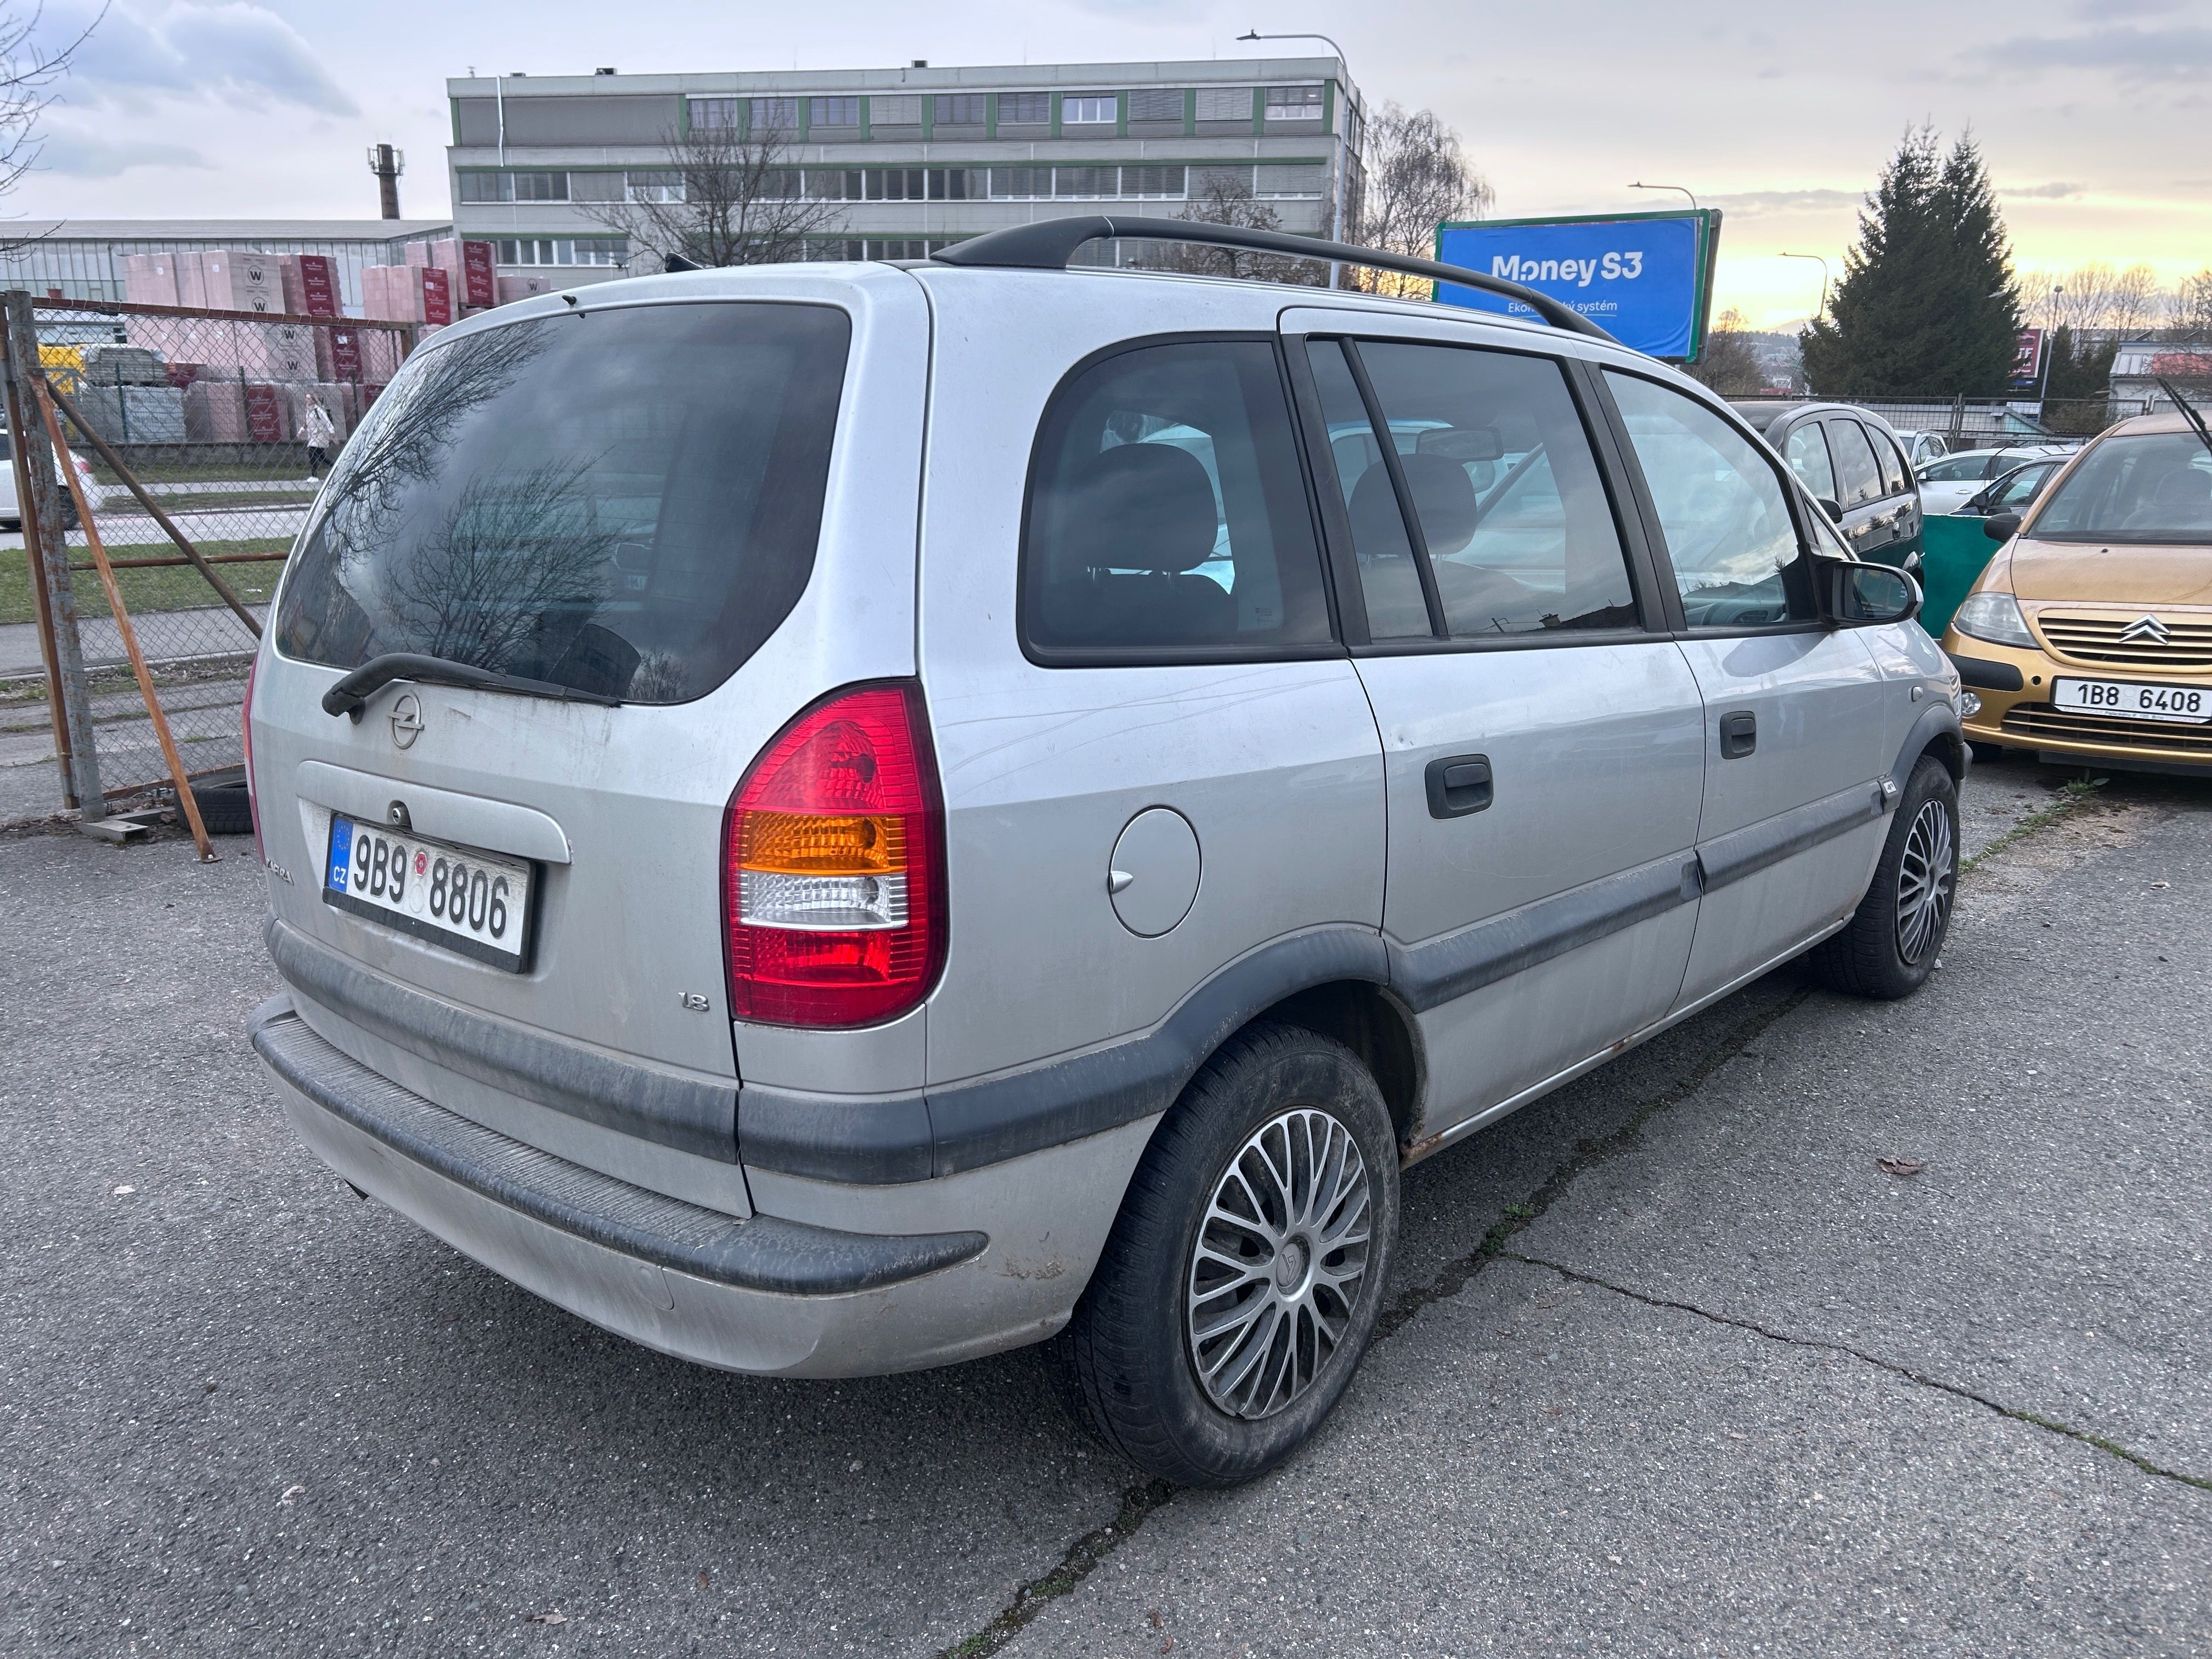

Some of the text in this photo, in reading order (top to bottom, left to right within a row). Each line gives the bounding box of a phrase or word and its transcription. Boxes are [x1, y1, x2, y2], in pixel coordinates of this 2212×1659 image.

[250, 271, 262, 281] W
[1492, 251, 1643, 287] Money S3
[1577, 300, 1618, 313] systém
[2078, 684, 2201, 712] 1B8 6408
[334, 866, 346, 884] CZ
[354, 834, 510, 939] 9B9 8806
